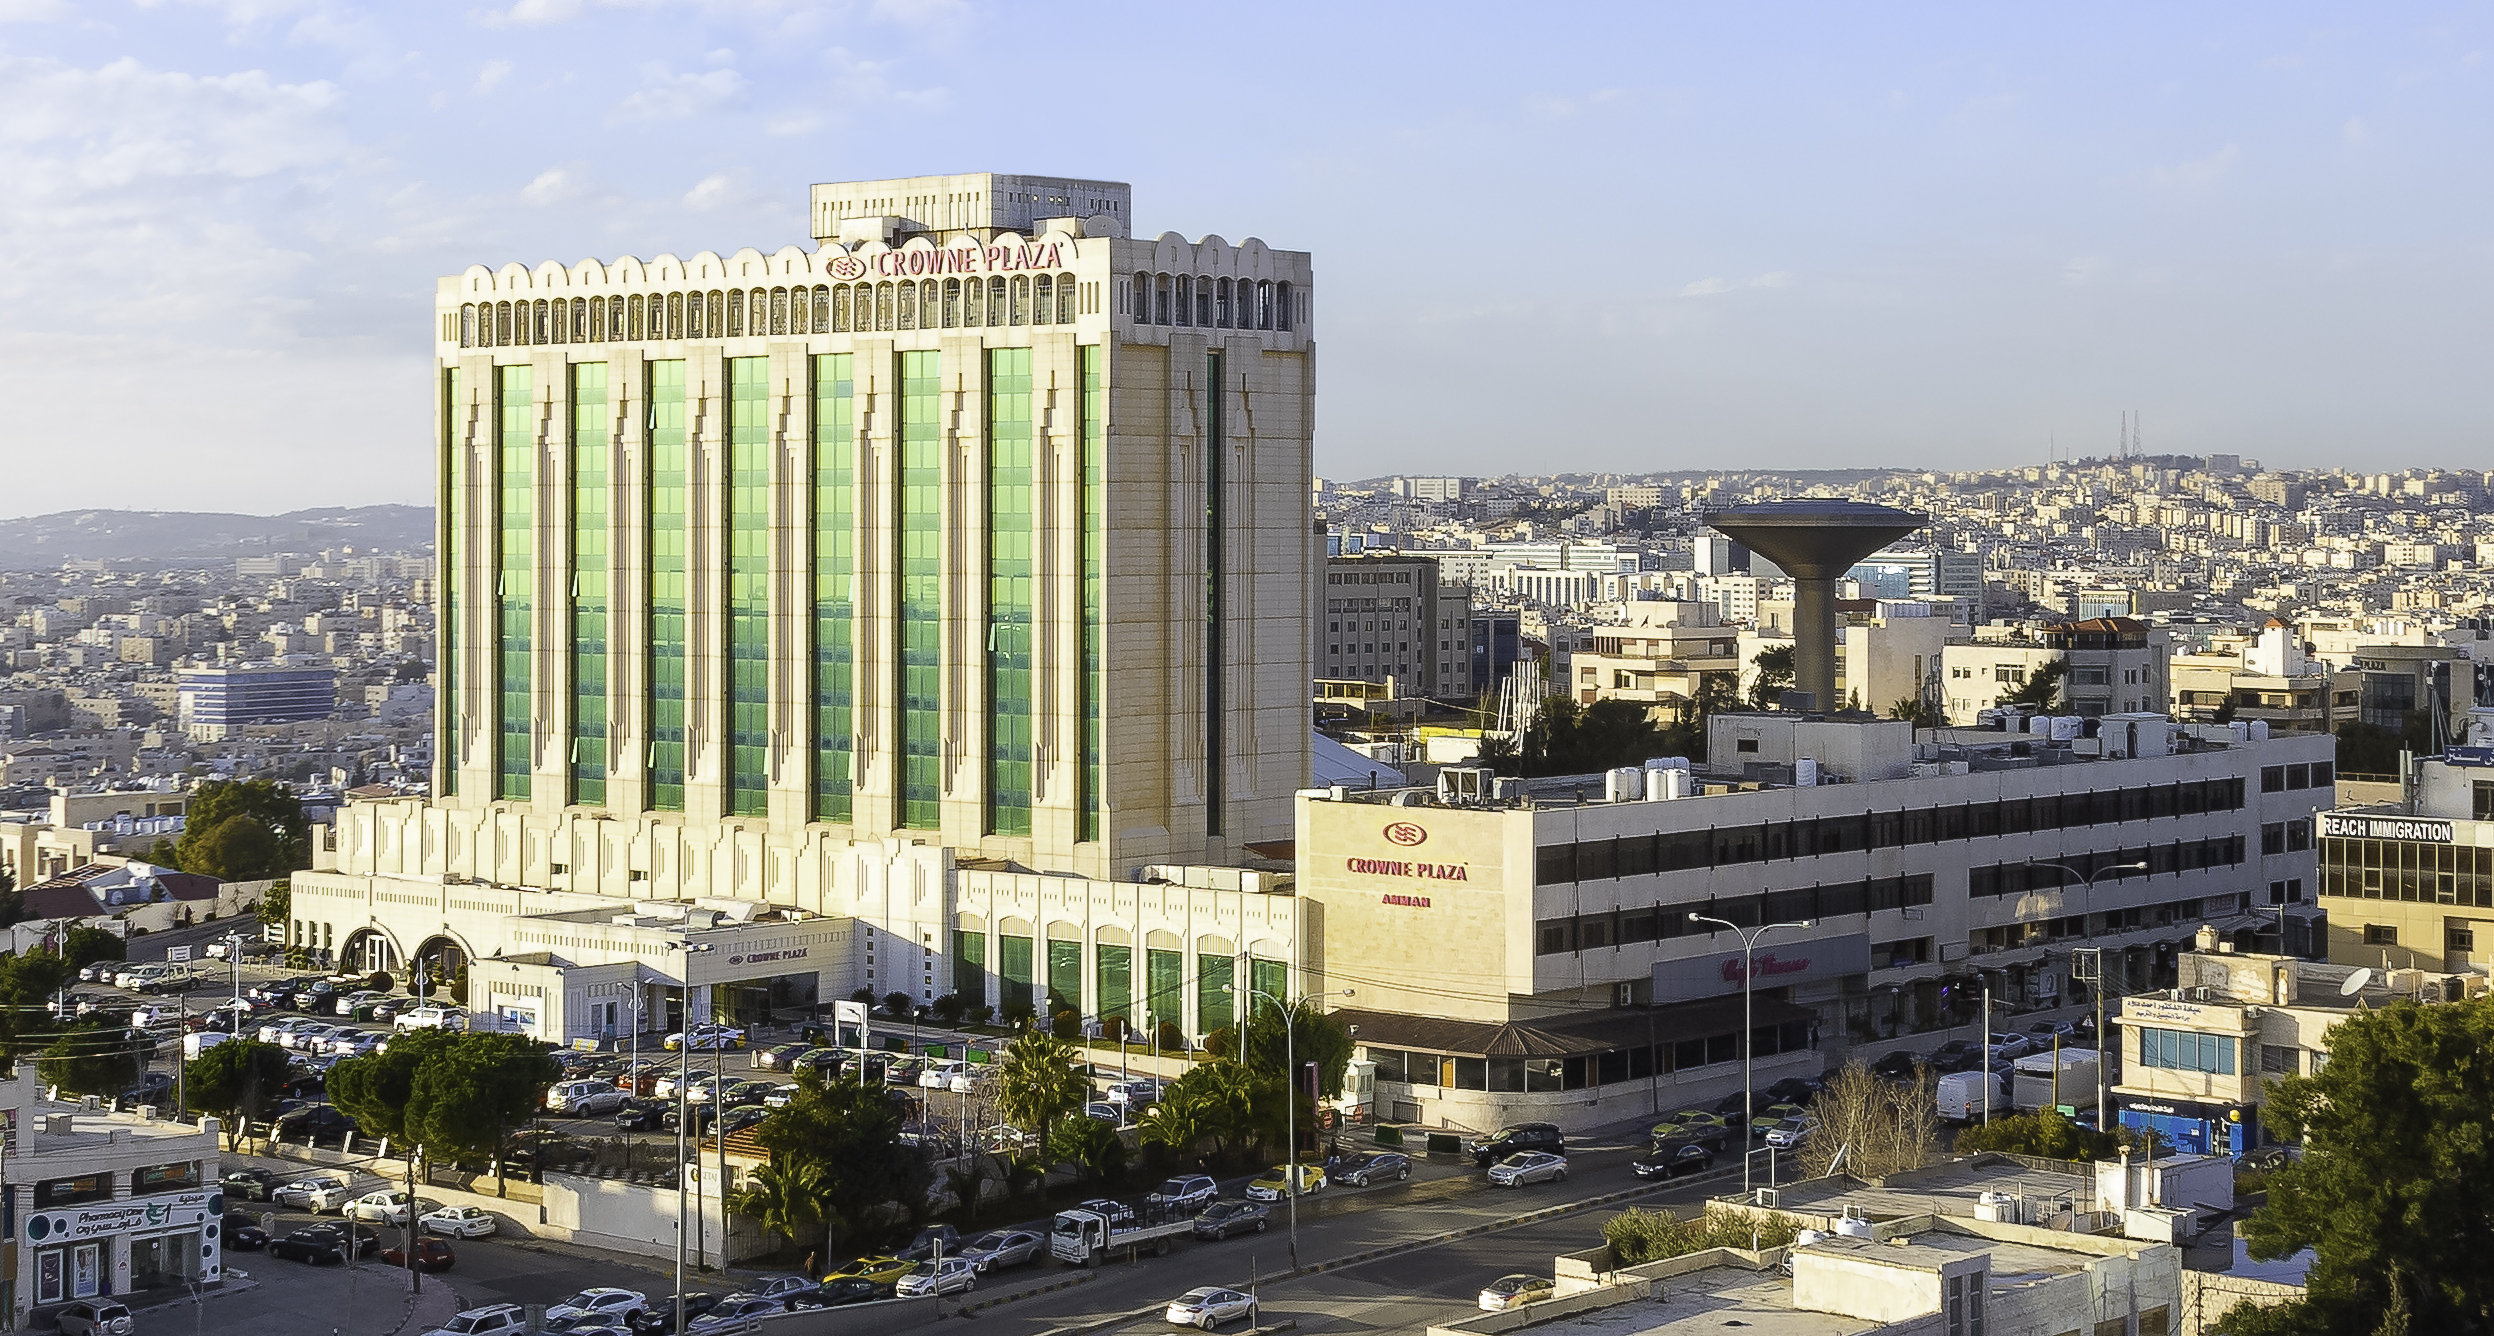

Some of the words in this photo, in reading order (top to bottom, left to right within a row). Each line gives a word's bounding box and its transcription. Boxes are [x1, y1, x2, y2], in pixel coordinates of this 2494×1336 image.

[878, 248, 976, 276] CROWNE
[986, 243, 1062, 271] PLAZA
[2324, 817, 2366, 836] REACH
[2369, 820, 2452, 841] IMMIGRATION
[1346, 857, 1413, 877] CROWNE
[1416, 863, 1468, 881] PLAZA
[1382, 893, 1431, 908] AMMAN
[747, 952, 780, 963] CROWNE
[783, 948, 808, 959] PLAZA
[79, 1209, 126, 1223] Pharmacy
